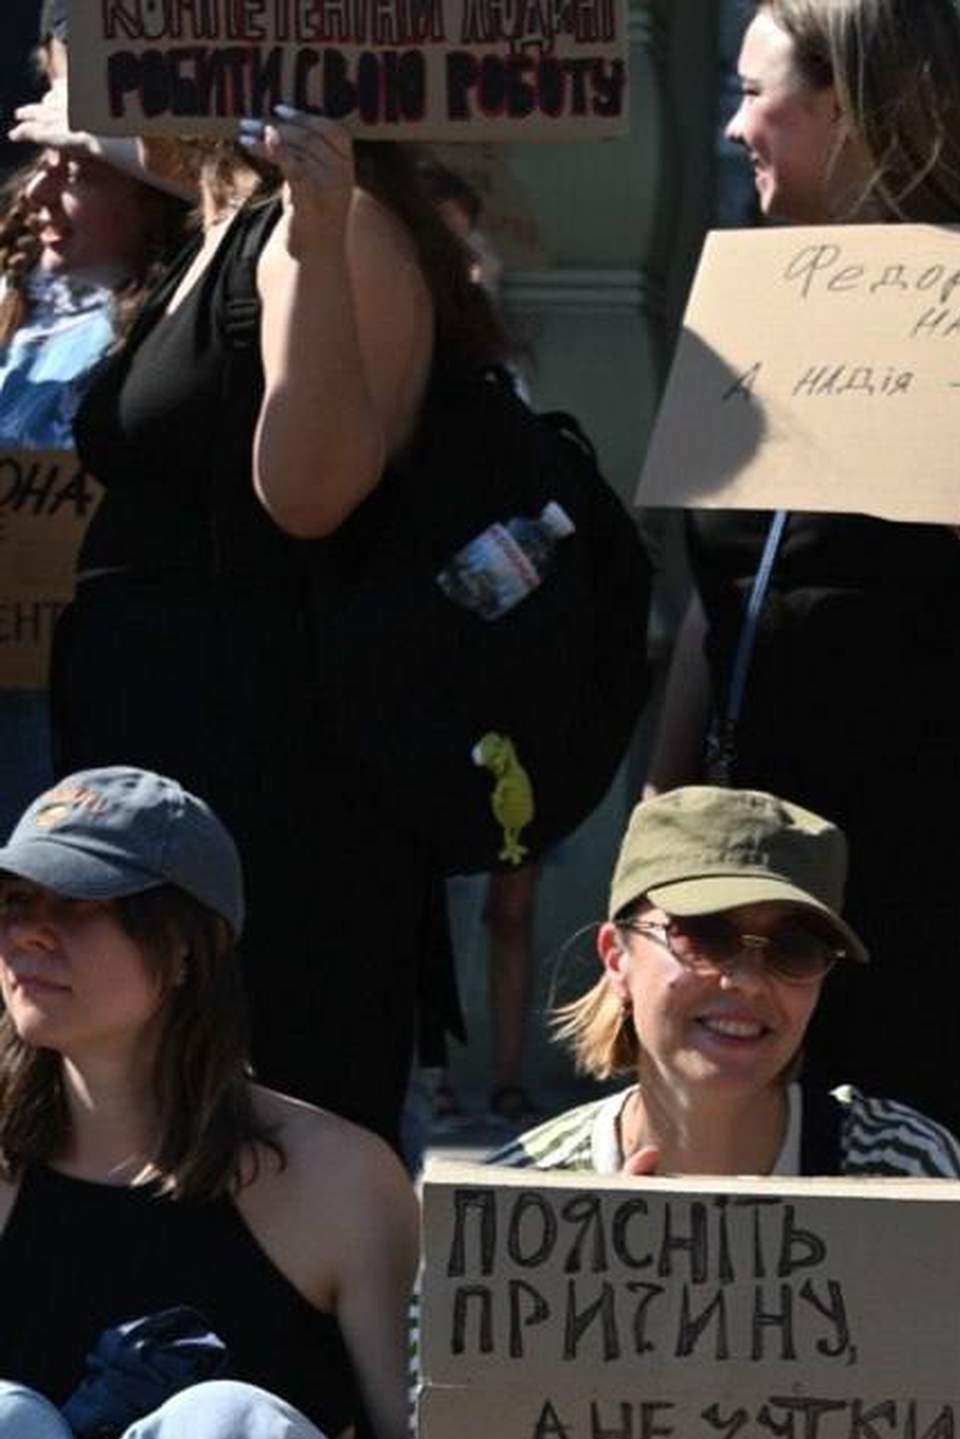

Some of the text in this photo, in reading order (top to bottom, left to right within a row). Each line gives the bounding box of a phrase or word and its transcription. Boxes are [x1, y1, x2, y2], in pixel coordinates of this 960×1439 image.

[107, 46, 625, 124] РОБИТИ СВОЮ РОБОТУ
[447, 1189, 826, 1284] ПОЯСНІТЬ
[450, 1278, 858, 1365] ПРИЧИНУ,
